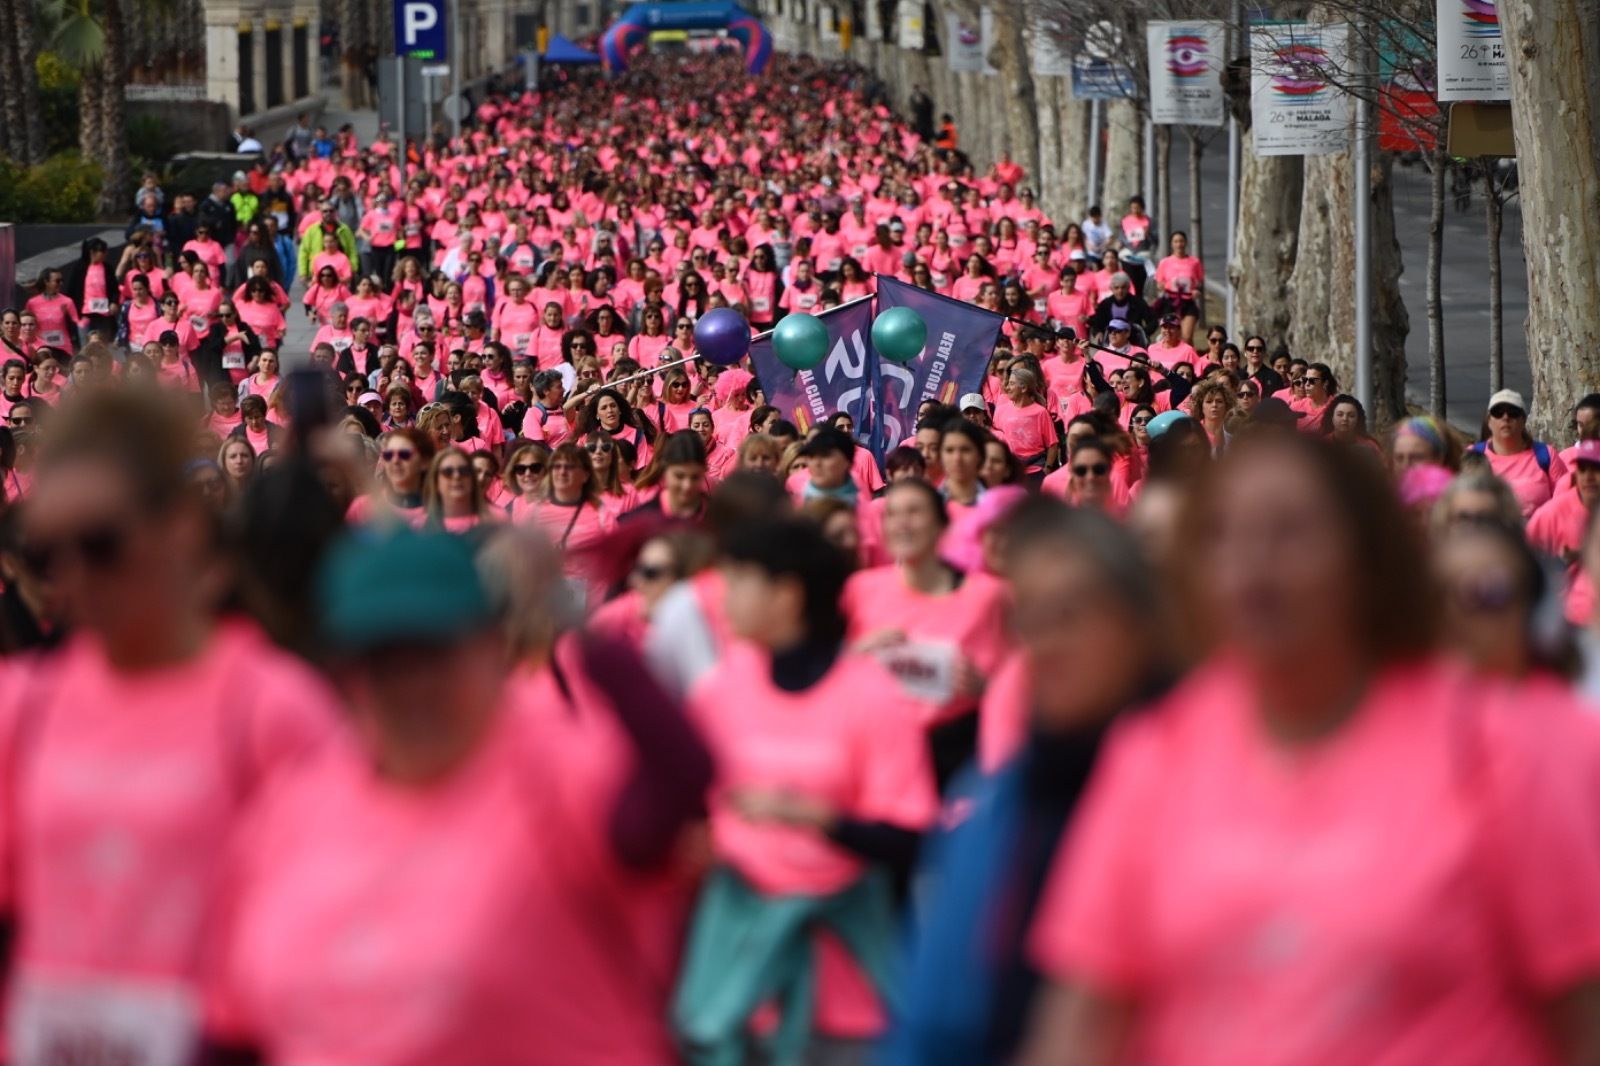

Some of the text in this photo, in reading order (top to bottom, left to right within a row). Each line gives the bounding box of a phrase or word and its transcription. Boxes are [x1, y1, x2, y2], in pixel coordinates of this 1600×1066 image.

[404, 3, 438, 45] P
[1461, 44, 1478, 59] 26
[1270, 111, 1284, 123] 26
[800, 369, 813, 386] AL
[805, 384, 825, 416] CLUB
